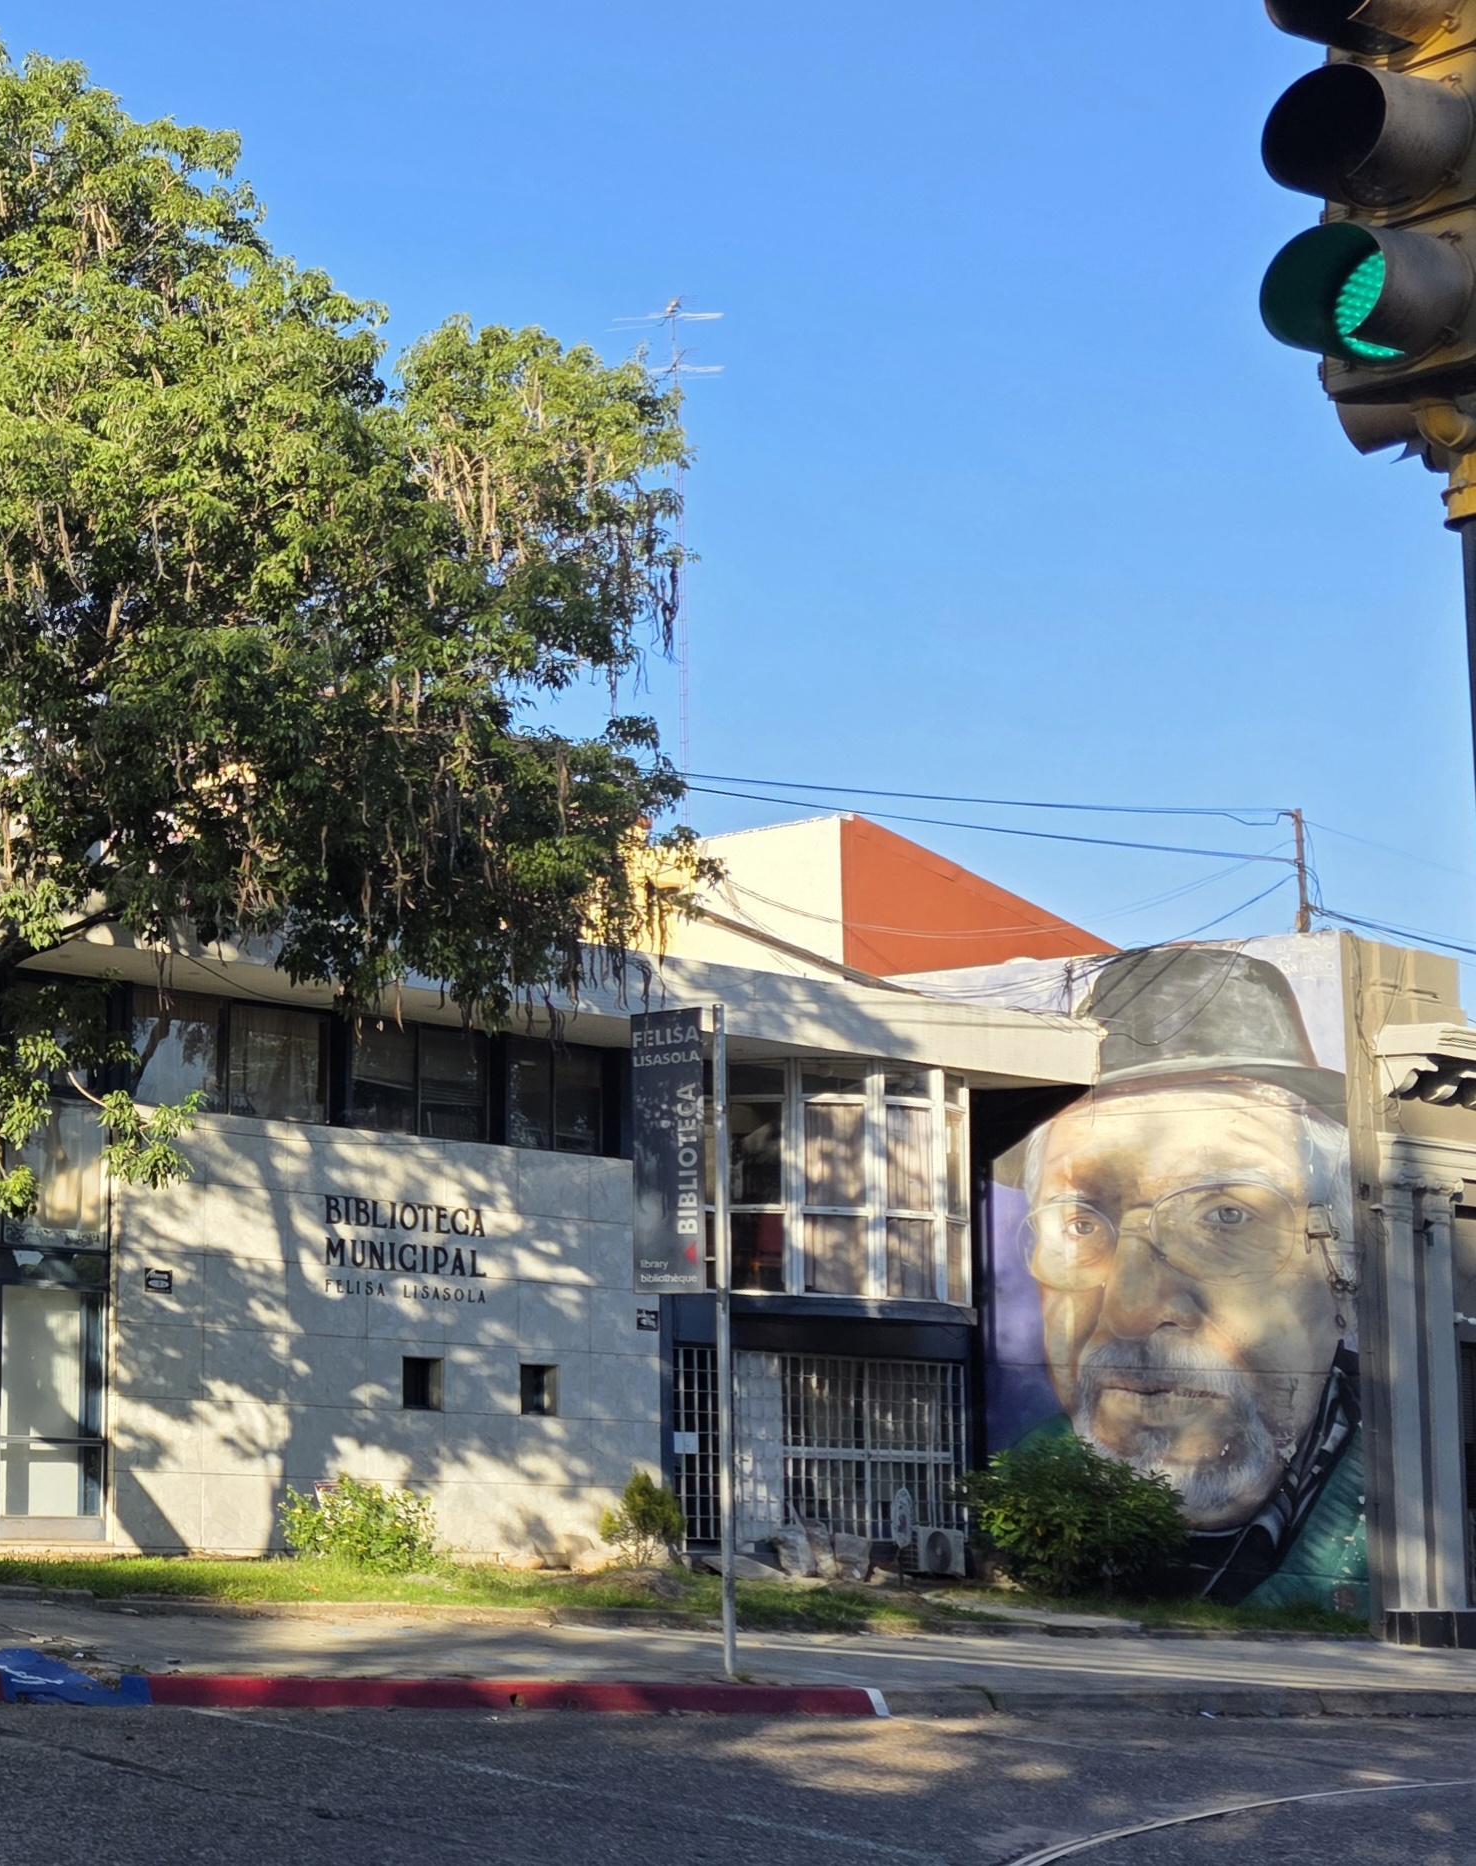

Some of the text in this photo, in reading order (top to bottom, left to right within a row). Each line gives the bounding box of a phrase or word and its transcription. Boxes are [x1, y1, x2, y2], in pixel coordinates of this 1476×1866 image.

[632, 1025, 700, 1048] FELISA
[632, 1049, 700, 1068] LISASOLA
[676, 1082, 698, 1235] BIBLIOTECA
[325, 1195, 486, 1237] BIBLIOTECA
[325, 1237, 487, 1278] MUNICIPAL
[640, 1259, 669, 1271] library
[640, 1273, 698, 1284] bibliothèque
[325, 1279, 487, 1304] FELISA LISASOLA
